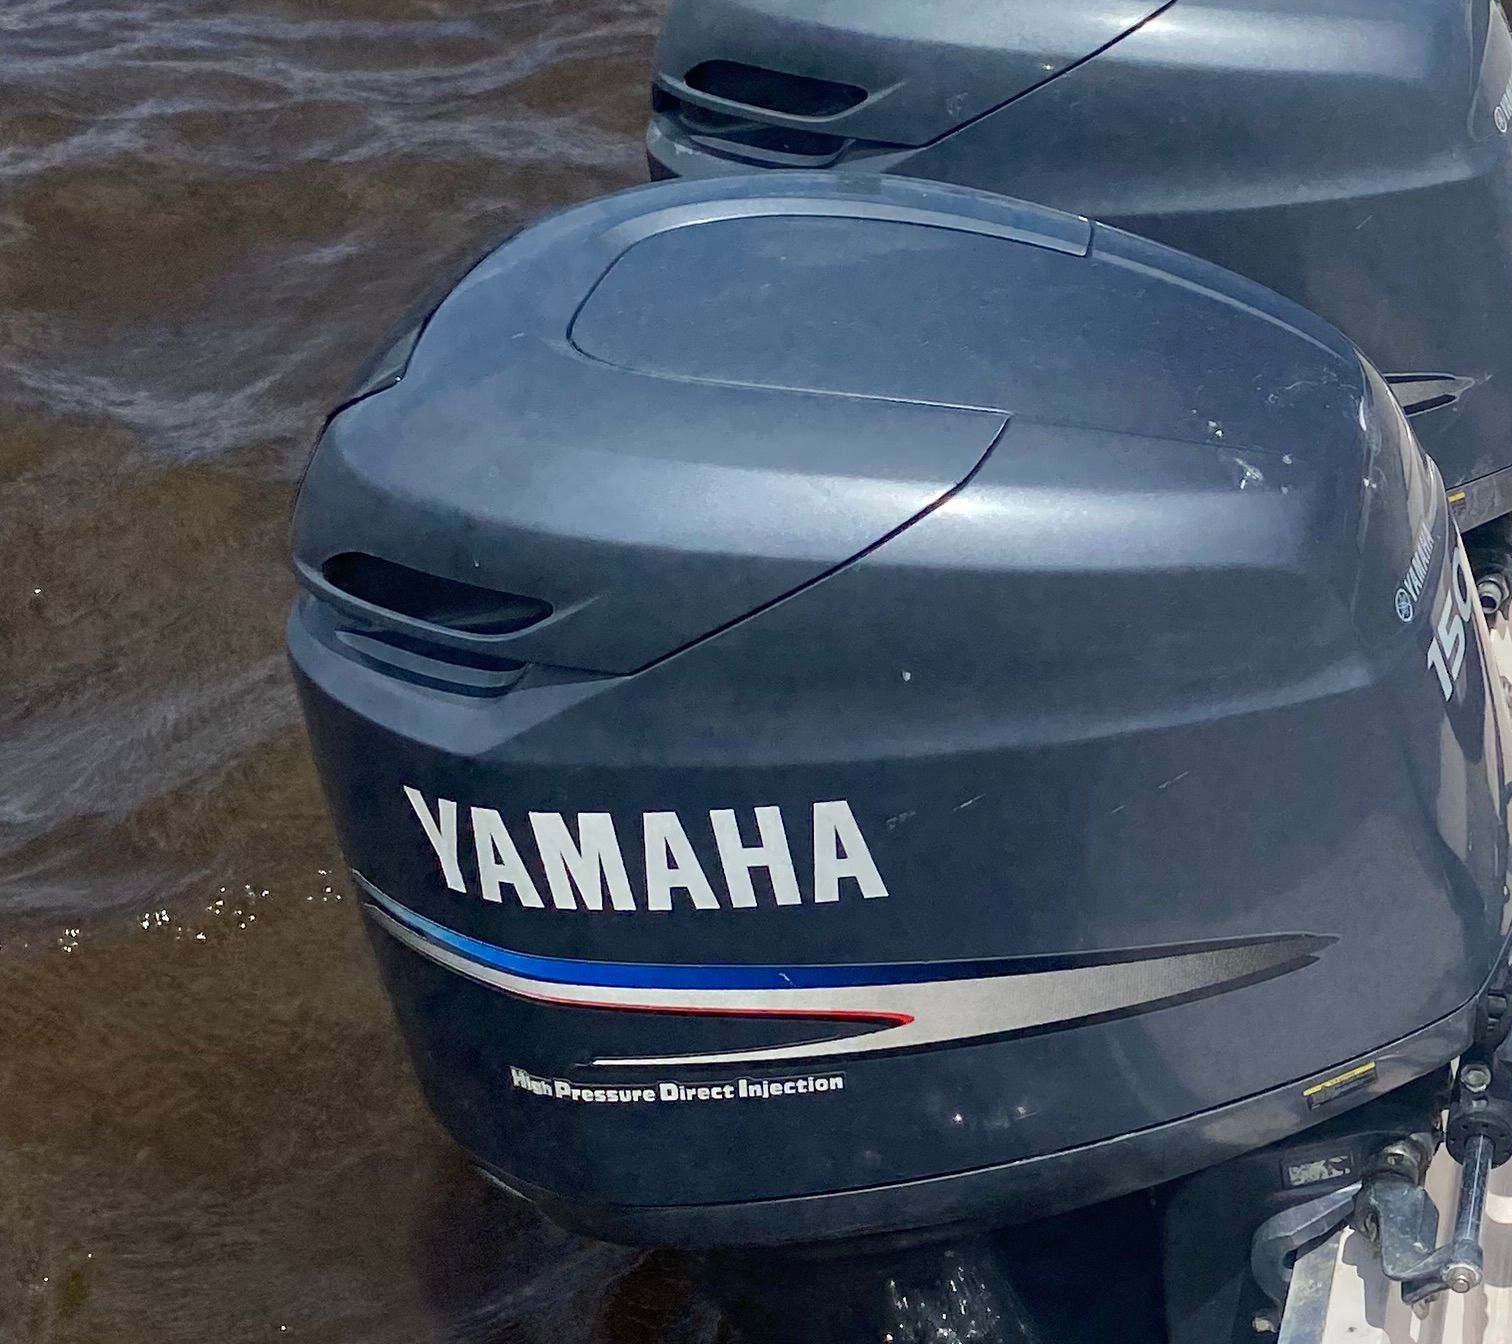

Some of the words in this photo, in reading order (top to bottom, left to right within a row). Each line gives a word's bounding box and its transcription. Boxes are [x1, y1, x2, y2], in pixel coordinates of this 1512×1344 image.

[1403, 521, 1434, 602] YAMAHA
[1426, 547, 1472, 701] 150
[403, 784, 889, 911] YAMAHA
[510, 1067, 552, 1096] High
[553, 1080, 656, 1102] Pressure
[659, 1082, 735, 1101] Direct
[738, 1075, 845, 1098] Injection
